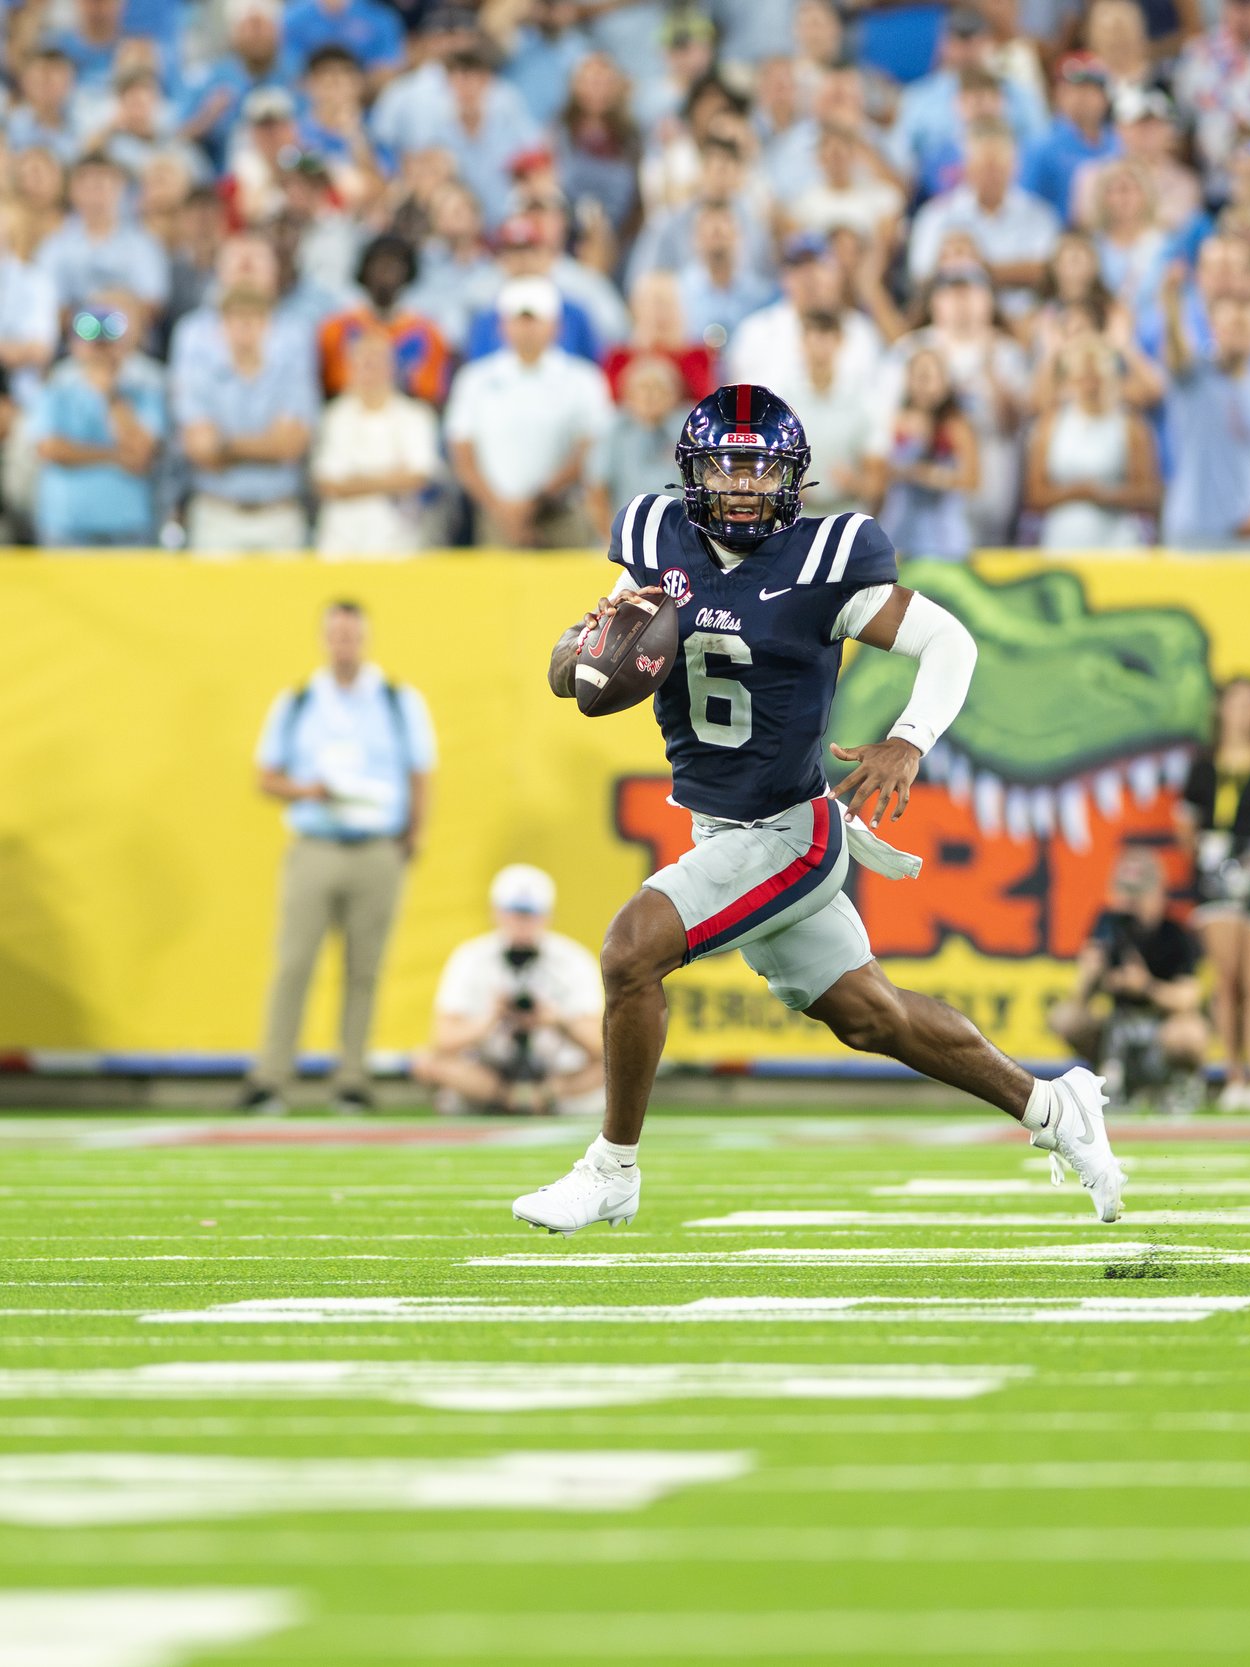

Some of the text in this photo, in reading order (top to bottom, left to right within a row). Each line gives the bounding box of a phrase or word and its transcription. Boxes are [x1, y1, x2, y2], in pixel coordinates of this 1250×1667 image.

[727, 433, 757, 444] REBS
[663, 569, 686, 598] SEC
[695, 607, 741, 631] Ole Miss
[683, 631, 753, 748] 6
